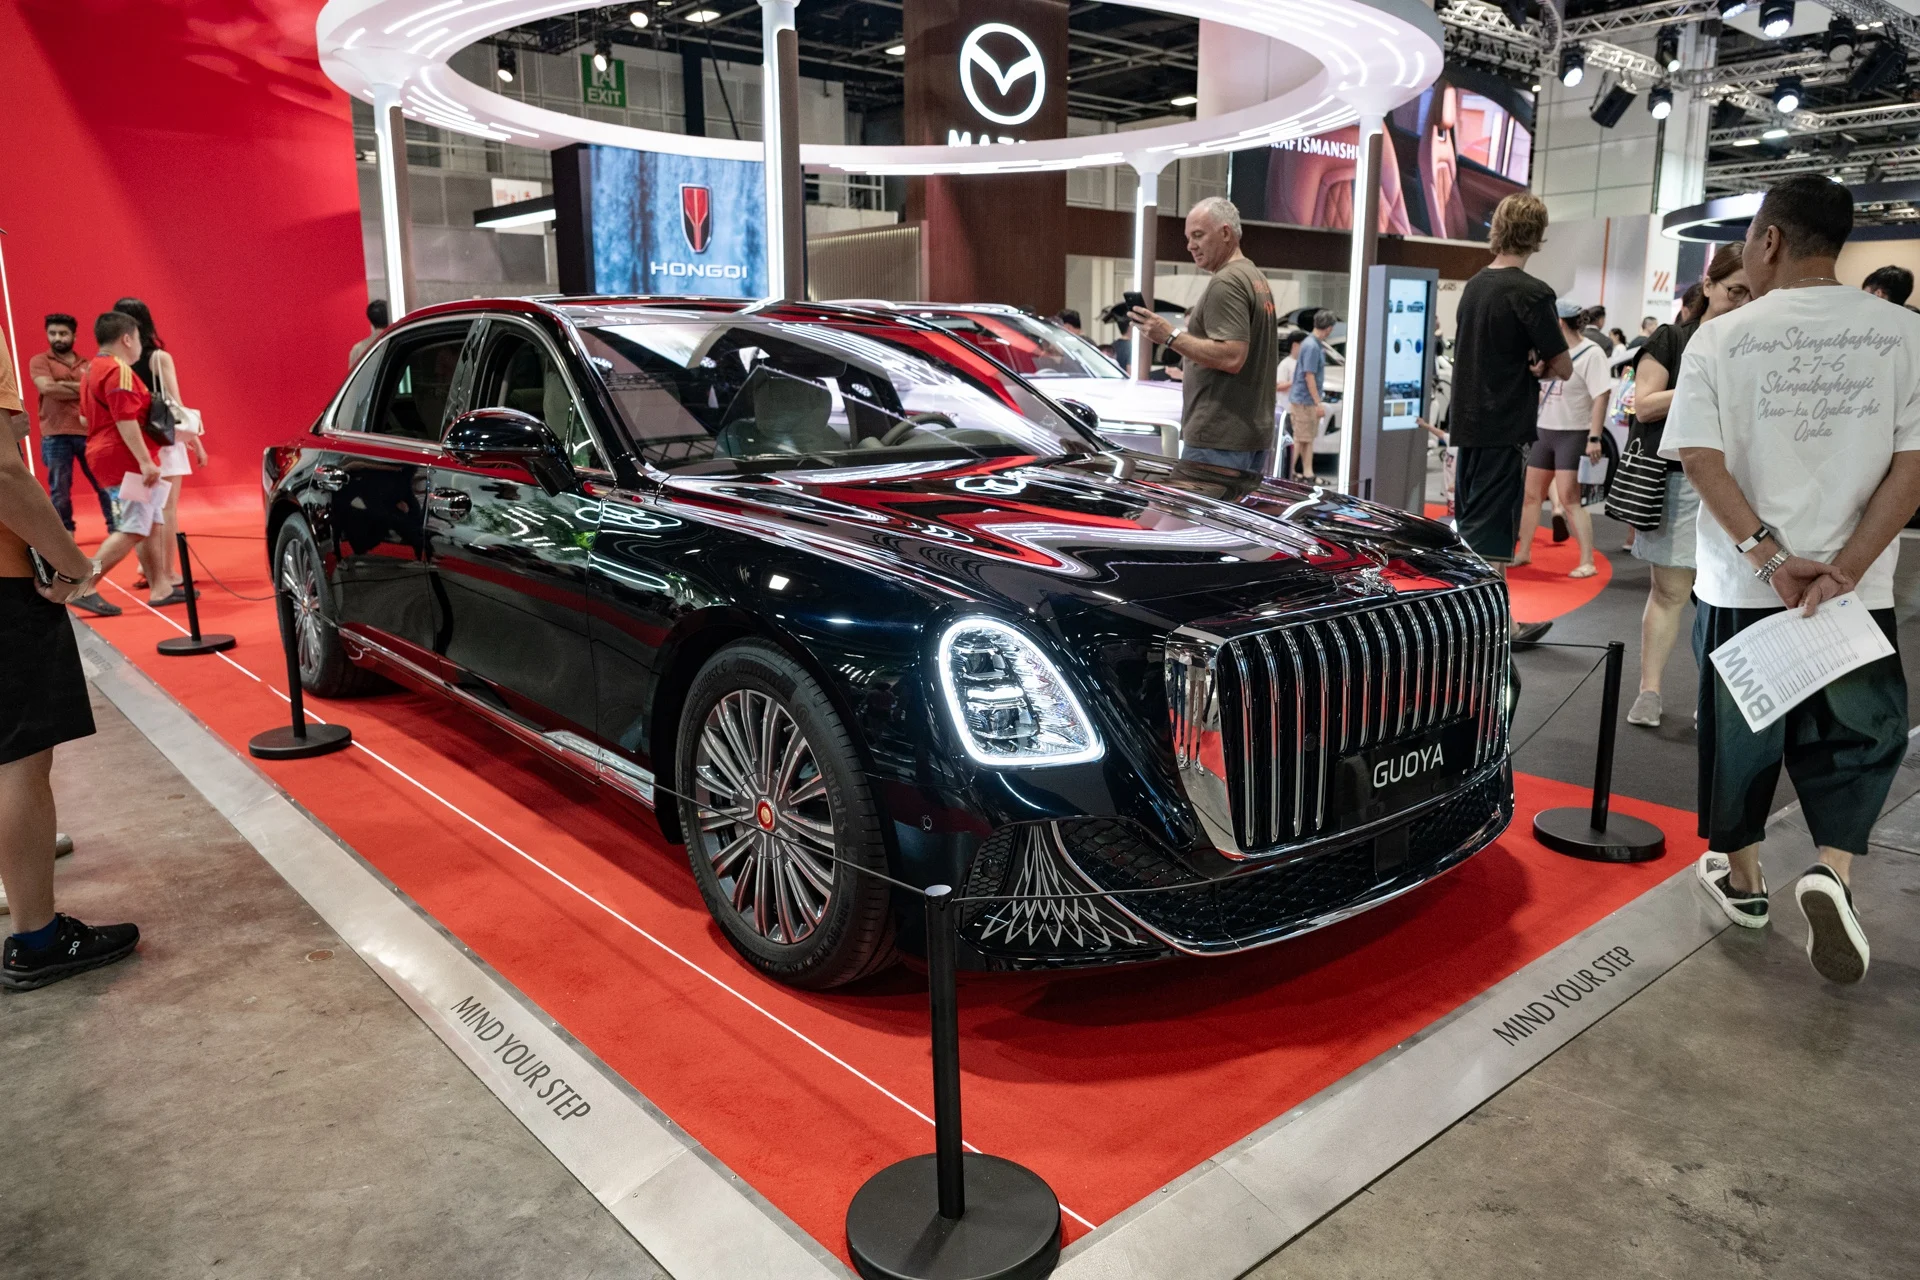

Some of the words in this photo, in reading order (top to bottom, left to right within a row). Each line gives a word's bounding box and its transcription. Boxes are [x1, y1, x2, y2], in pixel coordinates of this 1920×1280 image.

[588, 87, 622, 105] EXIT
[650, 261, 748, 279] HONGQI
[1787, 353, 1847, 374] 2-7-6
[1757, 397, 1808, 420] Chuo-ku
[1812, 397, 1881, 420] Osaka-shi
[1794, 419, 1833, 442] Osaka
[1716, 645, 1777, 723] BMW
[1373, 742, 1444, 788] GUOYA
[1492, 1001, 1556, 1047] MIND
[1542, 968, 1607, 1009] YOUR
[1591, 945, 1635, 978] STEP
[450, 995, 505, 1042] MIND
[493, 1032, 551, 1089] YOUR
[536, 1078, 592, 1121] STEP
